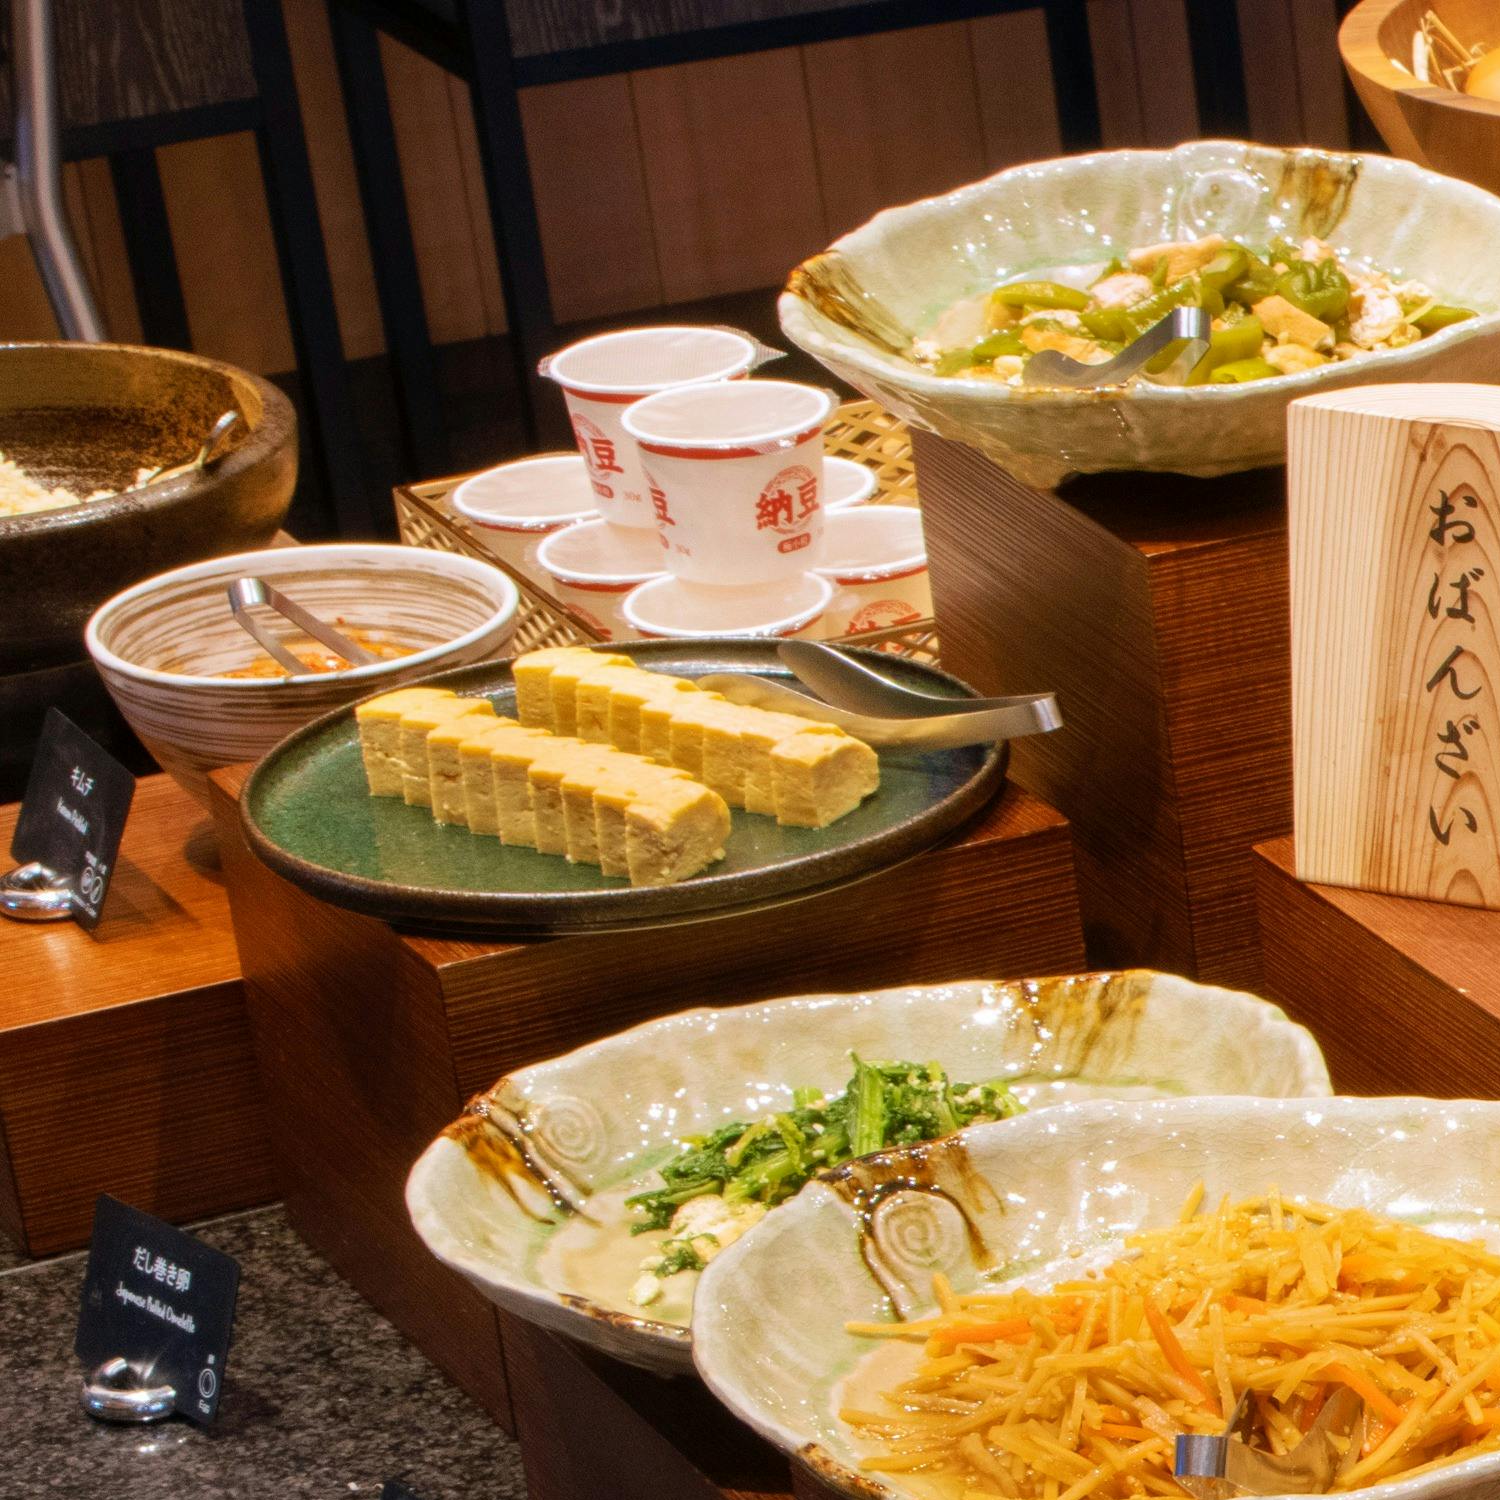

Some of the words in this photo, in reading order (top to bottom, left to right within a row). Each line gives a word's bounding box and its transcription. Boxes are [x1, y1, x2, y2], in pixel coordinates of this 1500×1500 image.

[755, 477, 820, 530] 納豆
[1427, 489, 1484, 846] おばんざい
[70, 765, 94, 797] キムチ
[133, 1246, 191, 1293] だし巻き卵
